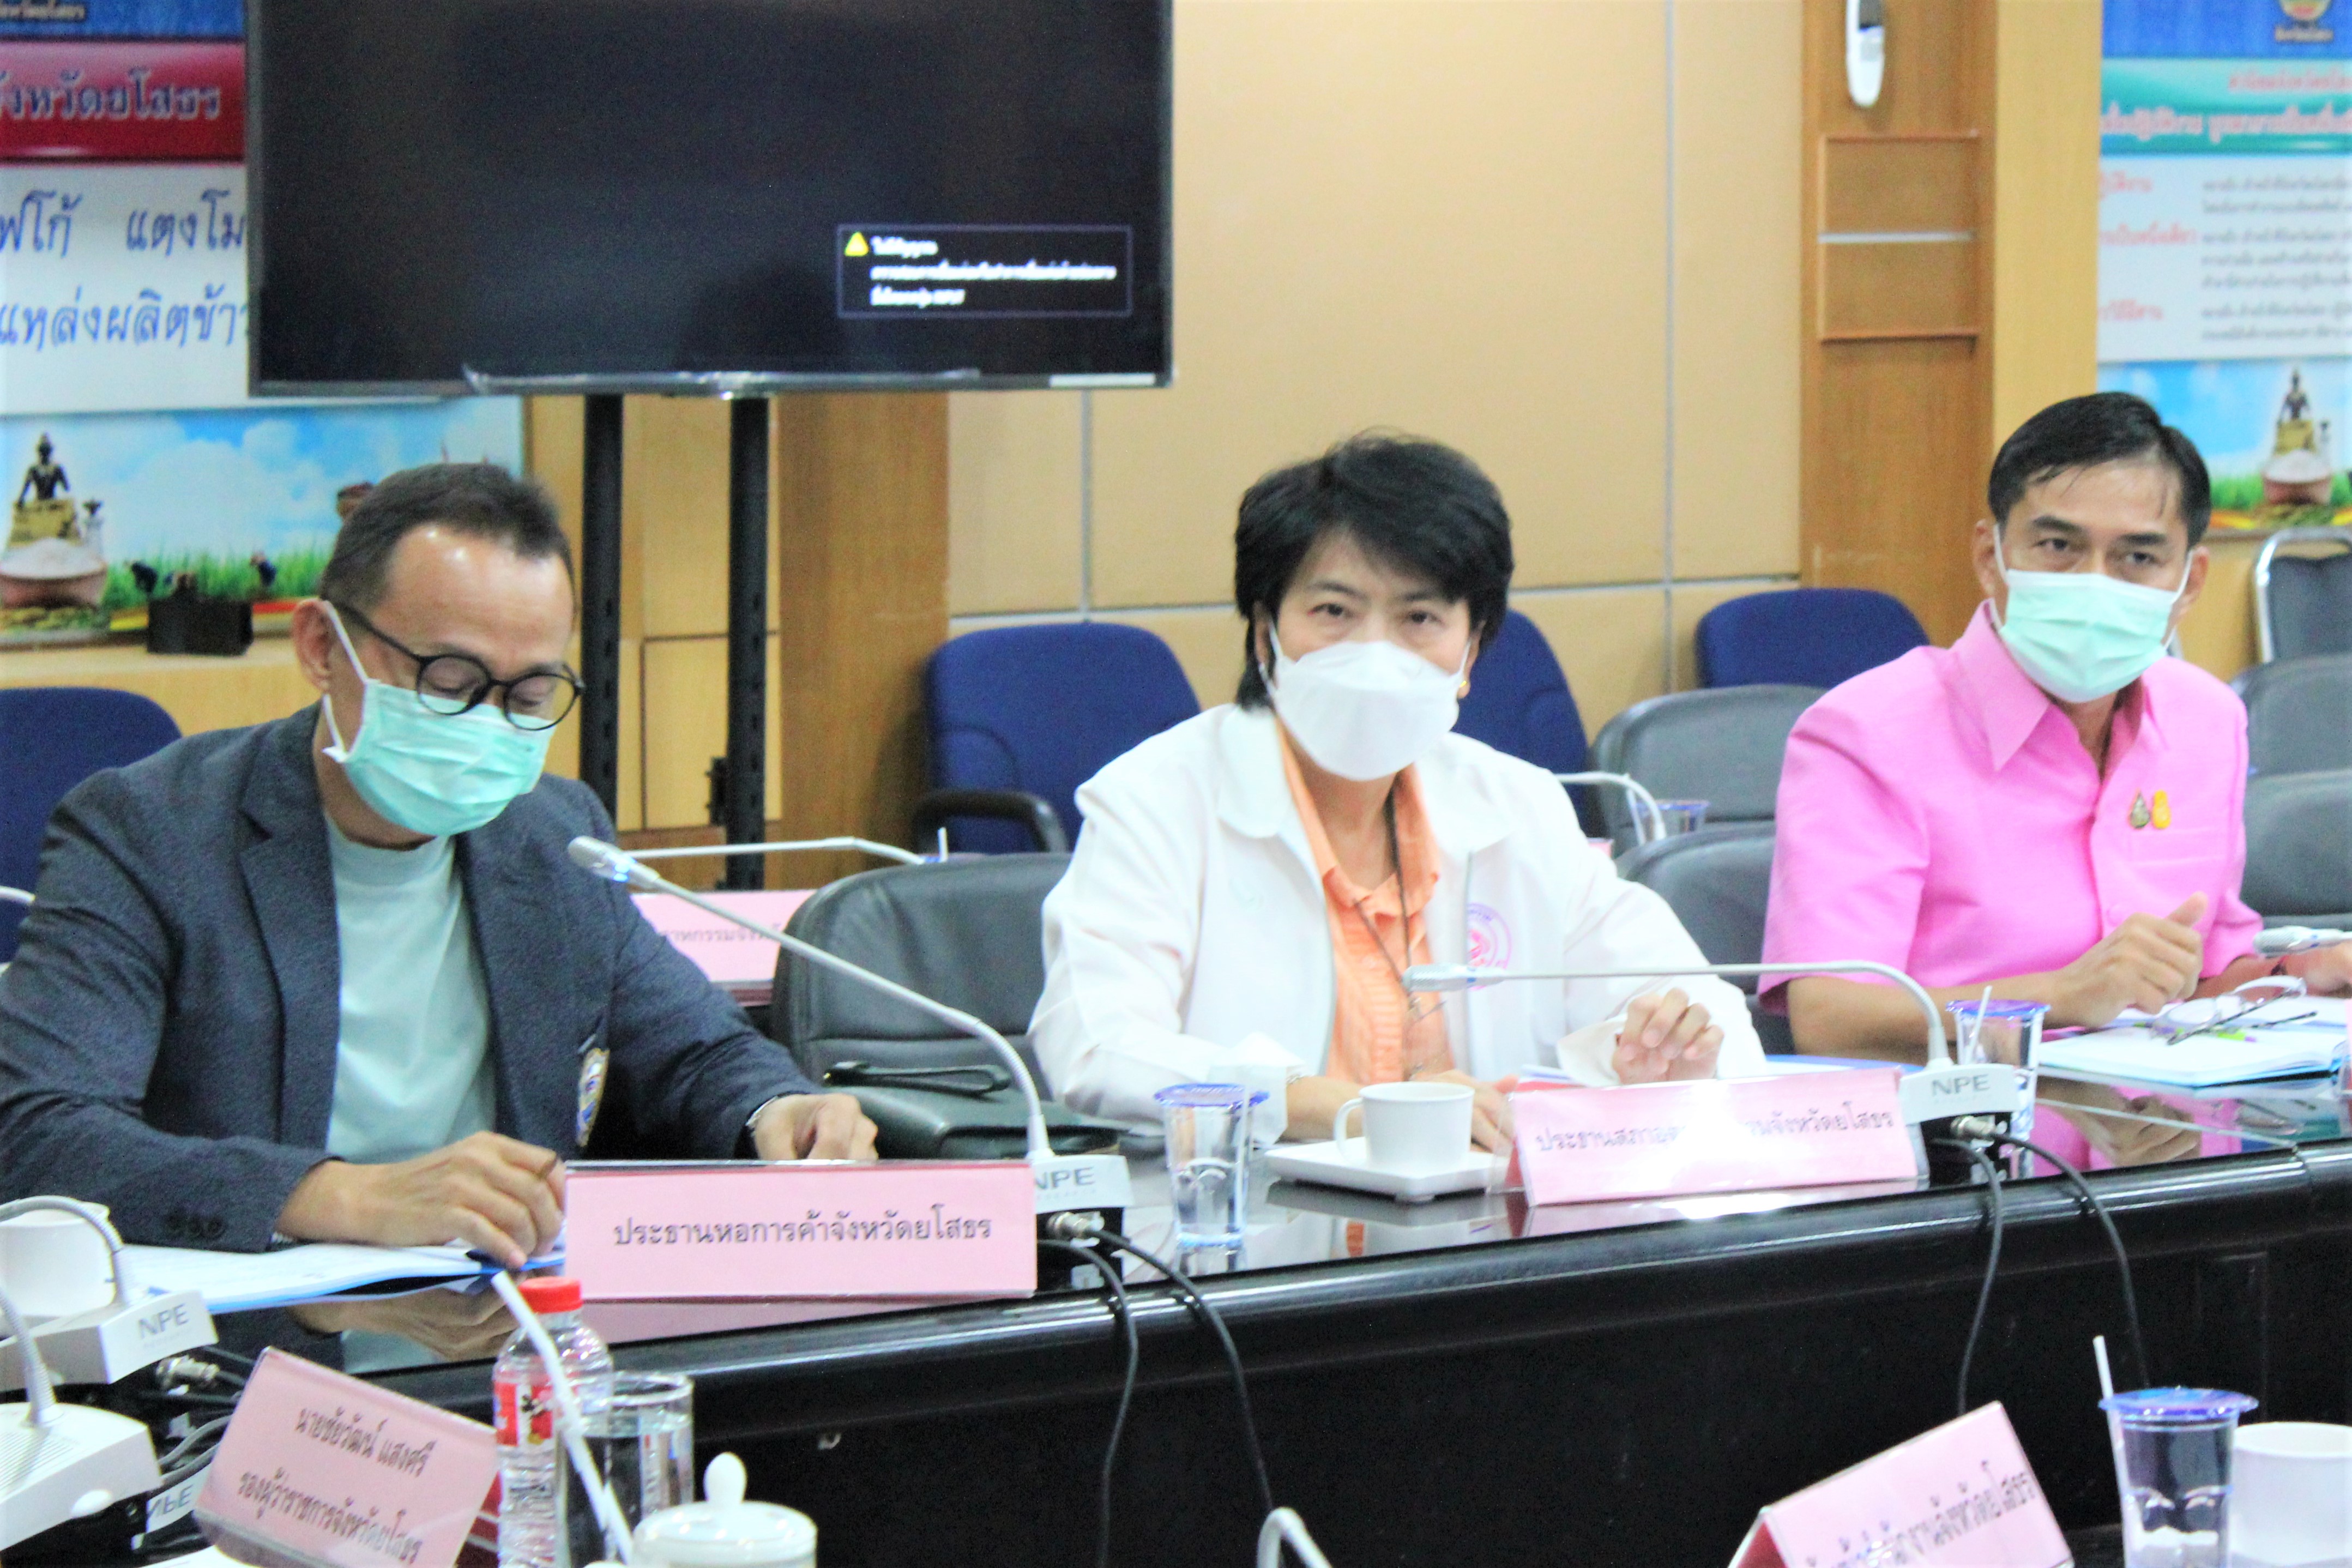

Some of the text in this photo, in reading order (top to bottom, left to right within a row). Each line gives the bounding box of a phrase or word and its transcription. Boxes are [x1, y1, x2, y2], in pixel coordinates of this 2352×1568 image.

[0, 284, 246, 352] แหล่งผลิตข้า
[1931, 1072, 1991, 1097] NPE
[613, 1202, 993, 1246] ประธานหอการค้าจังหวัดยโสธร
[138, 1302, 191, 1340] NPE
